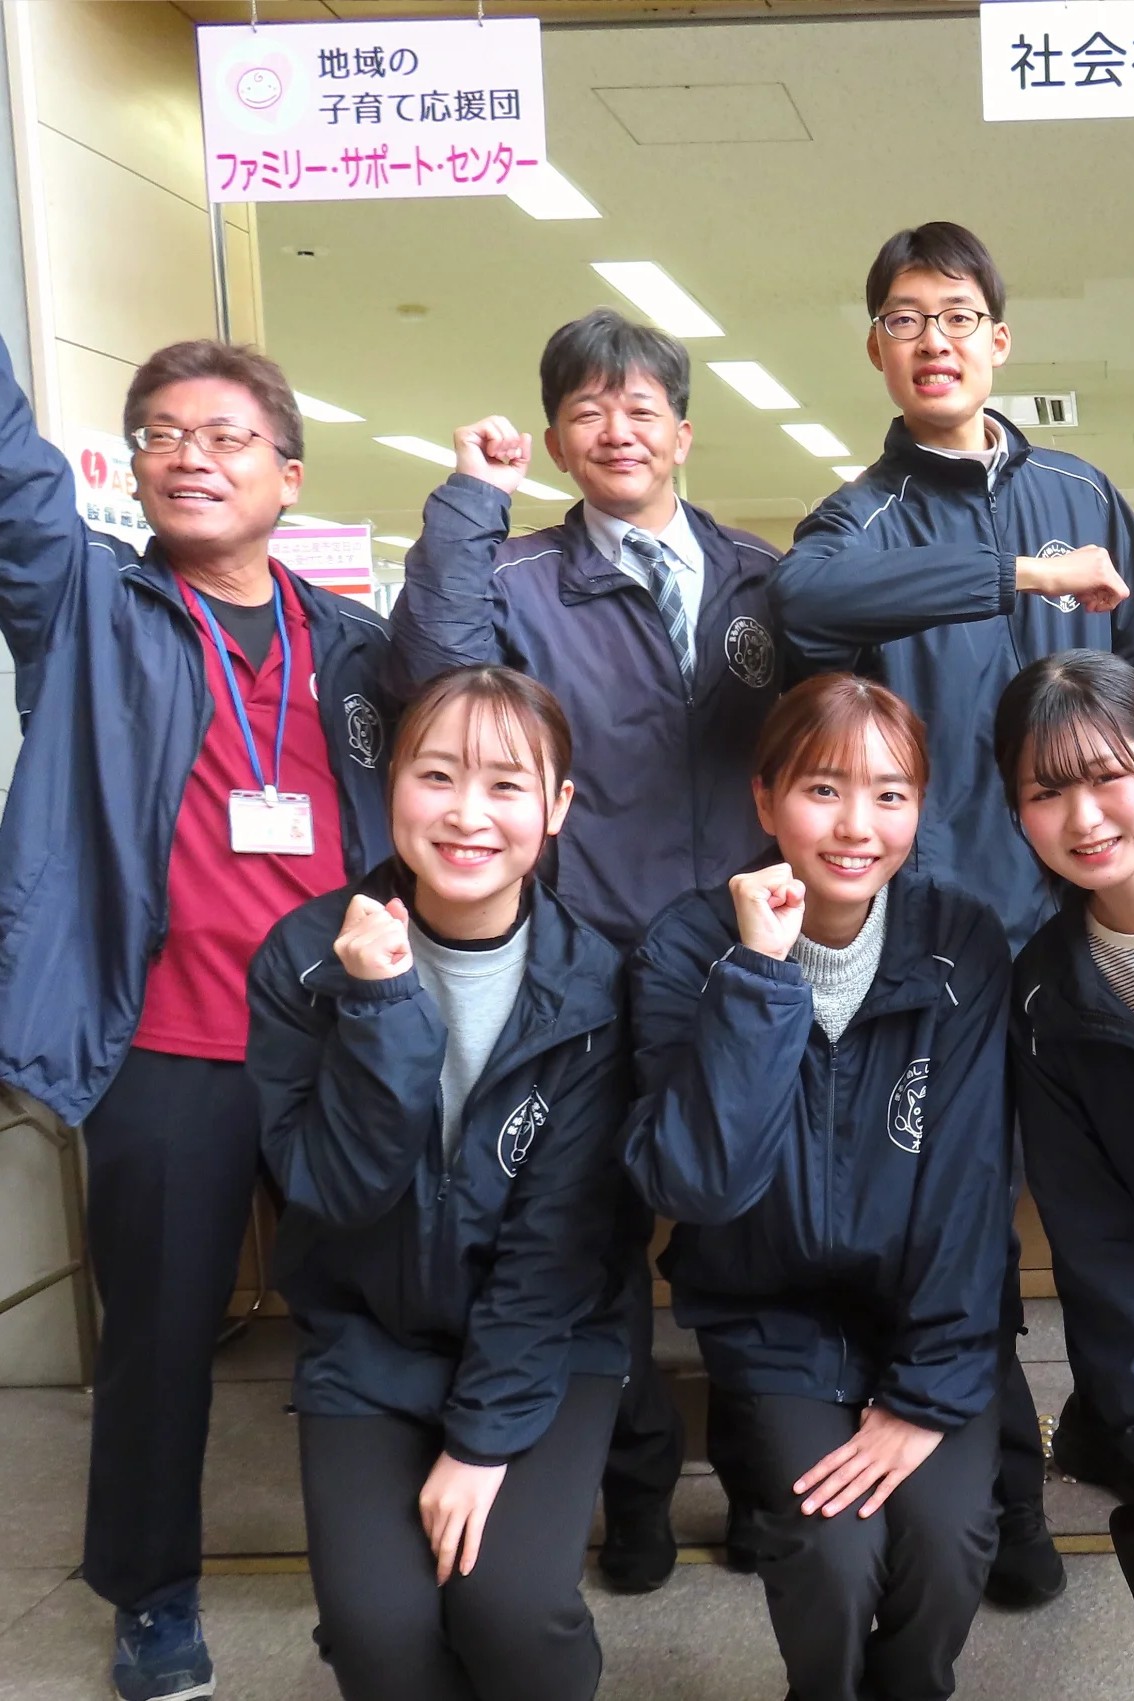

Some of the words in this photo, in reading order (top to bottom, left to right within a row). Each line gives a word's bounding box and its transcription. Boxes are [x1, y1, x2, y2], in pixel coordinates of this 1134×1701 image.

[318, 46, 419, 79] 地域の
[318, 88, 521, 125] 子育て応援団
[112, 469, 136, 495] AE
